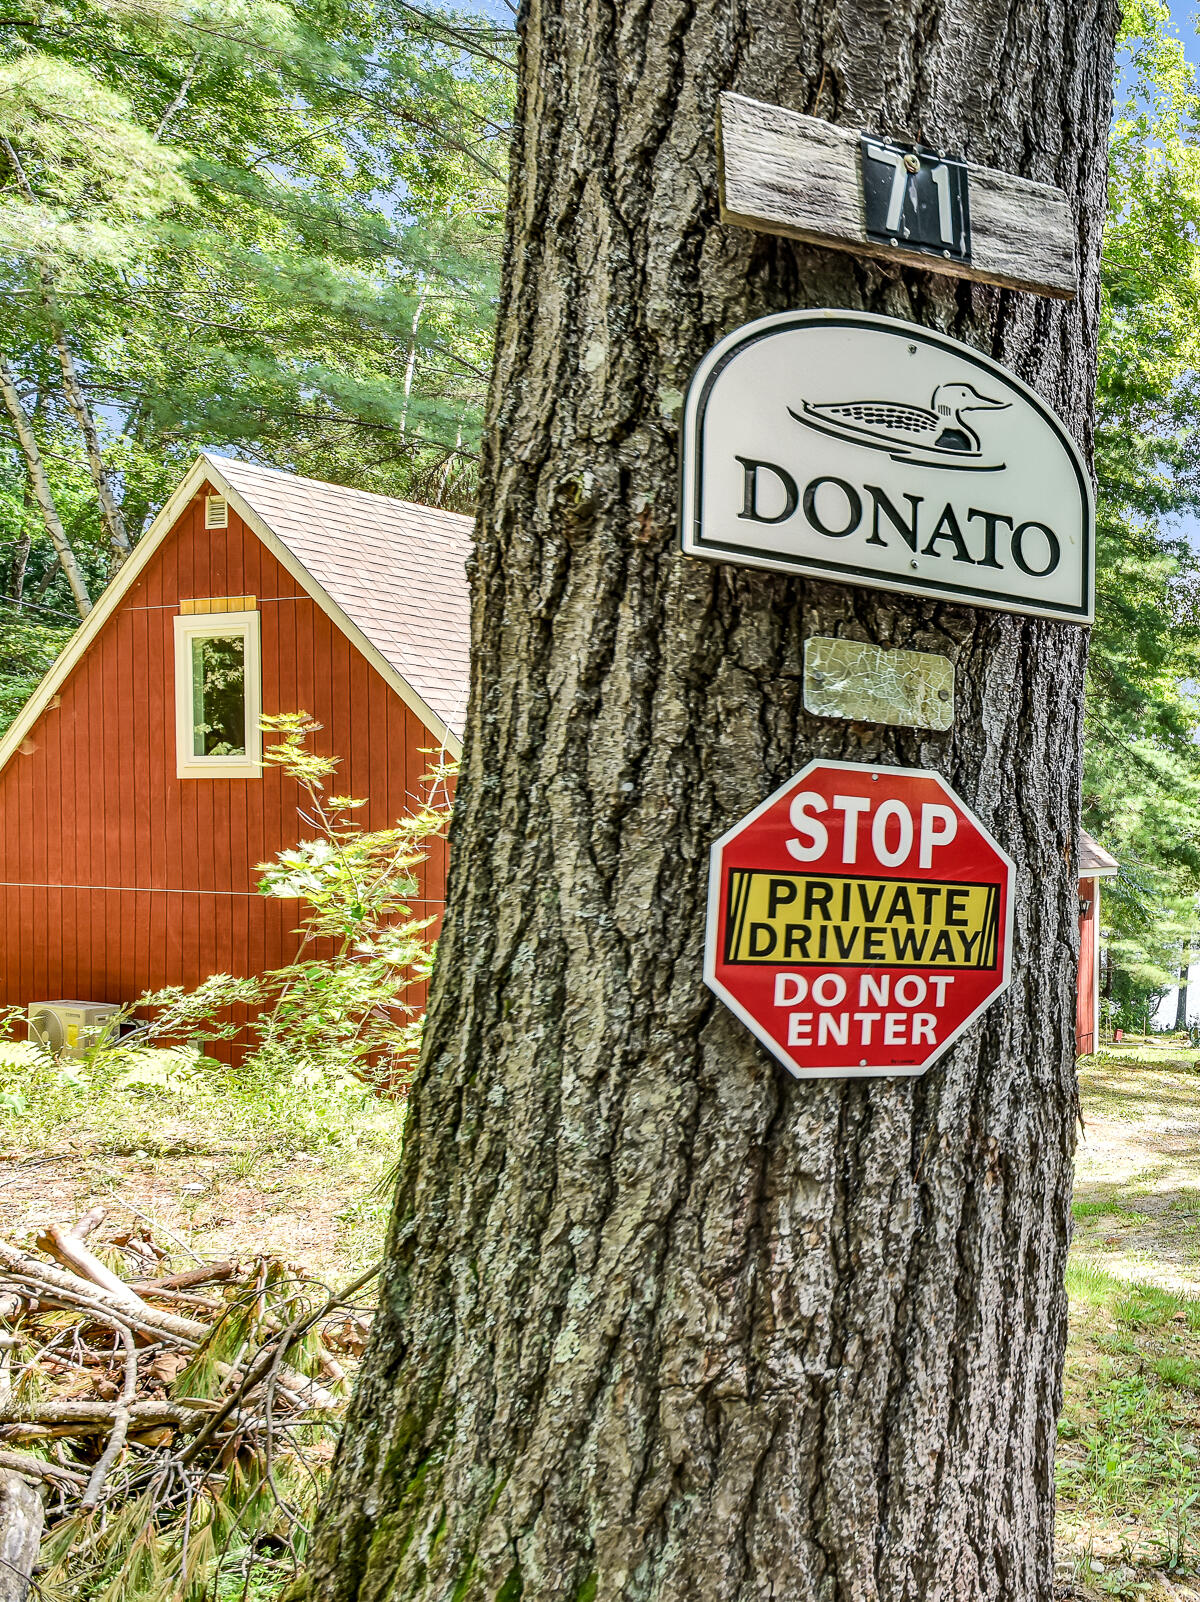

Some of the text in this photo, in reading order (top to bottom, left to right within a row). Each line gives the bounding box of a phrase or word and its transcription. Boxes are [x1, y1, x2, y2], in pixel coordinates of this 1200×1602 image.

[868, 144, 953, 245] 71
[734, 455, 1061, 577] DONATO
[785, 791, 958, 869] STOP
[767, 879, 970, 927] PRIVATE
[748, 922, 982, 963] DRIVEWAY
[773, 972, 955, 1008] DO NOT
[787, 1012, 938, 1047] ENTER
